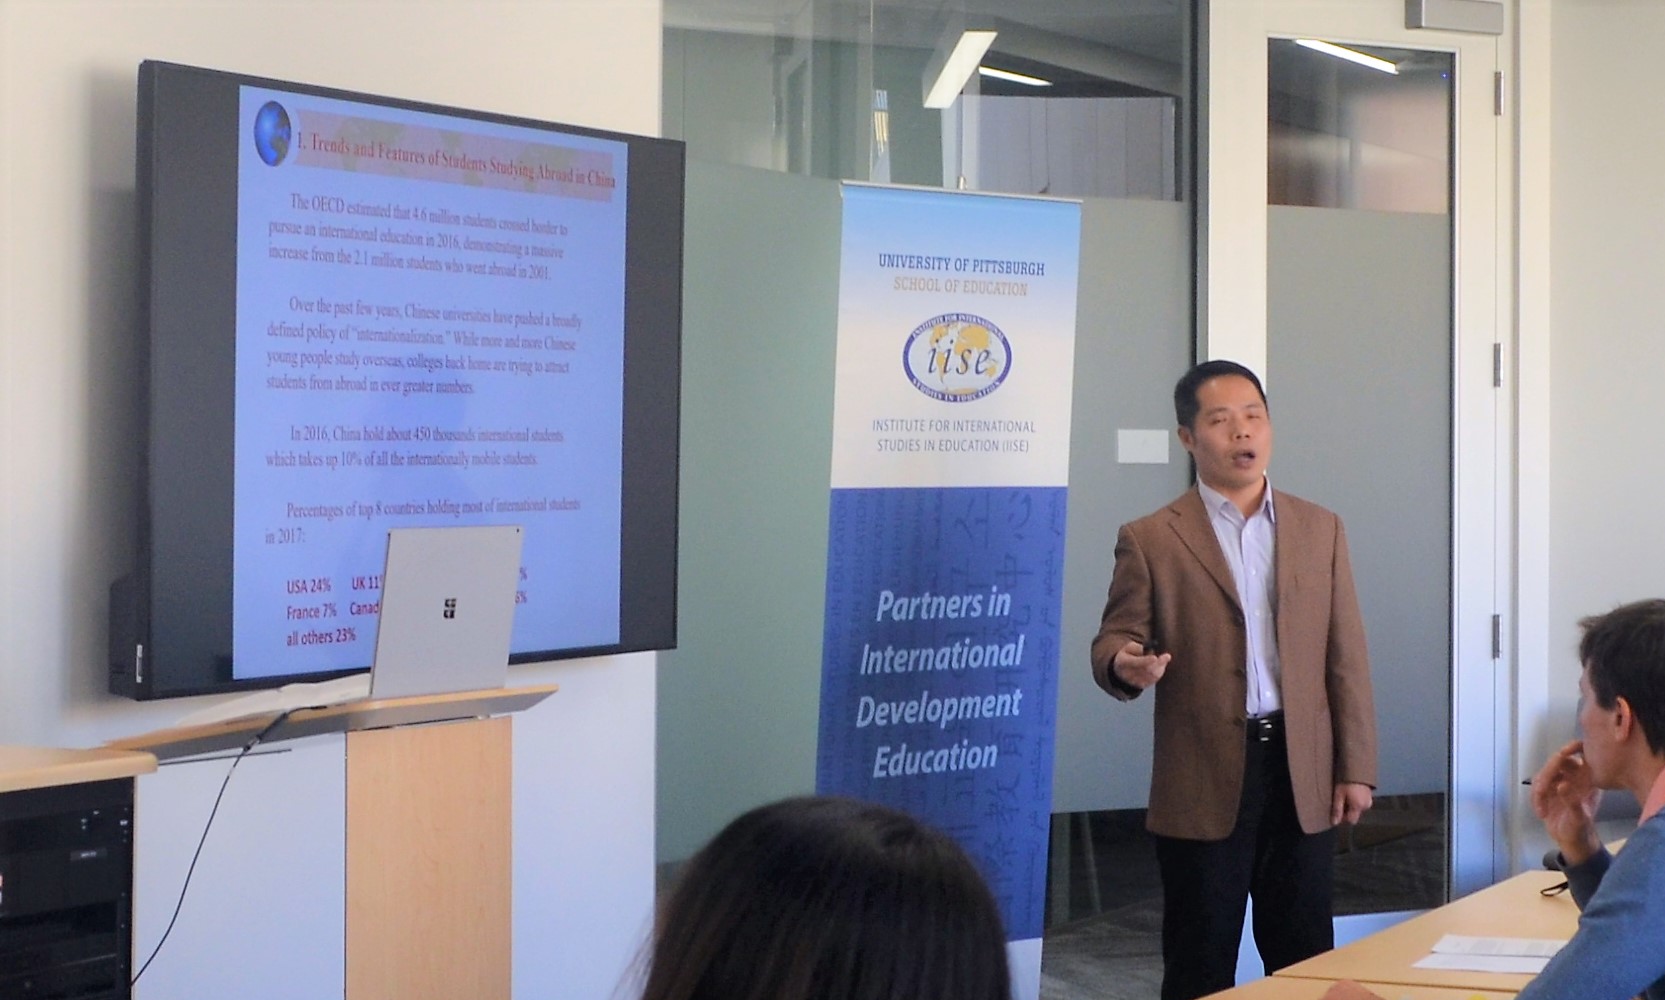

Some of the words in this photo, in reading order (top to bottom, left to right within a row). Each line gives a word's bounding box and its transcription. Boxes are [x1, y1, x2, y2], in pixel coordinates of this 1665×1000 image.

[311, 133, 350, 153] Trends
[354, 141, 374, 158] and
[379, 142, 425, 164] Features
[428, 150, 440, 166] of
[442, 152, 487, 172] Students
[490, 157, 534, 182] Studying
[538, 164, 573, 183] Abroad
[576, 169, 585, 184] in
[588, 170, 616, 188] China
[291, 192, 309, 210] The
[312, 195, 345, 213] OECD
[347, 203, 391, 218] estimated
[393, 204, 410, 220] that
[430, 208, 460, 225] million
[462, 213, 497, 230] students
[269, 221, 302, 237] pursue
[304, 225, 316, 236] an
[319, 221, 377, 242] international
[380, 228, 423, 247] education
[426, 231, 434, 247] in
[268, 241, 308, 260] increase
[312, 246, 334, 262] from
[338, 248, 352, 264] the
[371, 252, 404, 268] million
[406, 256, 443, 271] students
[446, 258, 464, 273] who
[878, 253, 950, 272] UNIVERSITY
[954, 257, 970, 272] OF
[972, 258, 1046, 276] PITTSBURGH
[893, 276, 941, 293] SCHOOL
[944, 278, 960, 294] OF
[963, 279, 1028, 297] EDUCATION
[290, 296, 315, 312] Over
[317, 298, 332, 314] the
[334, 302, 353, 318] past
[356, 300, 372, 316] few
[404, 302, 441, 320] Chinese
[442, 305, 492, 322] universities
[267, 320, 304, 338] defined
[306, 323, 336, 344] policy
[339, 324, 349, 340] of
[454, 330, 480, 346] While
[267, 351, 298, 368] young
[300, 350, 333, 368] people
[335, 351, 360, 370] study
[406, 354, 444, 372] colleges
[445, 354, 466, 370] back
[928, 338, 991, 375] iise
[267, 374, 307, 390] students
[310, 374, 332, 390] from
[335, 376, 367, 391] abroad
[370, 377, 379, 391] in
[381, 382, 401, 392] ever
[402, 381, 434, 396] greater
[290, 426, 300, 441] In
[304, 425, 330, 442] 2016,
[333, 426, 361, 441] China
[364, 426, 384, 441] hold
[386, 426, 412, 441] about
[414, 426, 431, 441] 450
[433, 427, 476, 442] thousands
[478, 427, 529, 442] international
[872, 419, 926, 432] INSTITUTE
[929, 420, 950, 432] FOR
[953, 420, 1036, 434] INTERNATIONAL
[877, 438, 920, 452] STUDIES
[924, 439, 935, 452] IN
[938, 439, 999, 452] EDUCATION
[1002, 440, 1030, 454] (IISE)
[266, 451, 296, 466] which
[298, 450, 323, 466] takes
[326, 455, 338, 470] up
[342, 451, 362, 466] 10%
[364, 450, 376, 466] of
[376, 451, 388, 466] all
[390, 450, 404, 466] the
[407, 450, 469, 469] internationally
[287, 502, 344, 522] Percentages
[346, 500, 357, 516] of
[358, 503, 374, 520] top
[384, 500, 424, 515] countries
[427, 500, 460, 518] holding
[462, 500, 483, 513] most
[484, 498, 496, 512] of
[496, 498, 547, 512] international
[266, 528, 275, 544] in
[287, 578, 308, 594] USA
[310, 577, 332, 593] 24%
[352, 576, 366, 590] UK
[287, 604, 320, 620] France
[322, 602, 337, 618] 7%
[350, 600, 380, 616] Canad
[876, 588, 983, 622] Partners
[988, 584, 1012, 618] in
[287, 630, 298, 646] all
[301, 630, 333, 645] others
[336, 627, 356, 642] 23%
[860, 634, 1026, 676] International
[856, 688, 1023, 729] Development
[872, 738, 999, 779] Education
